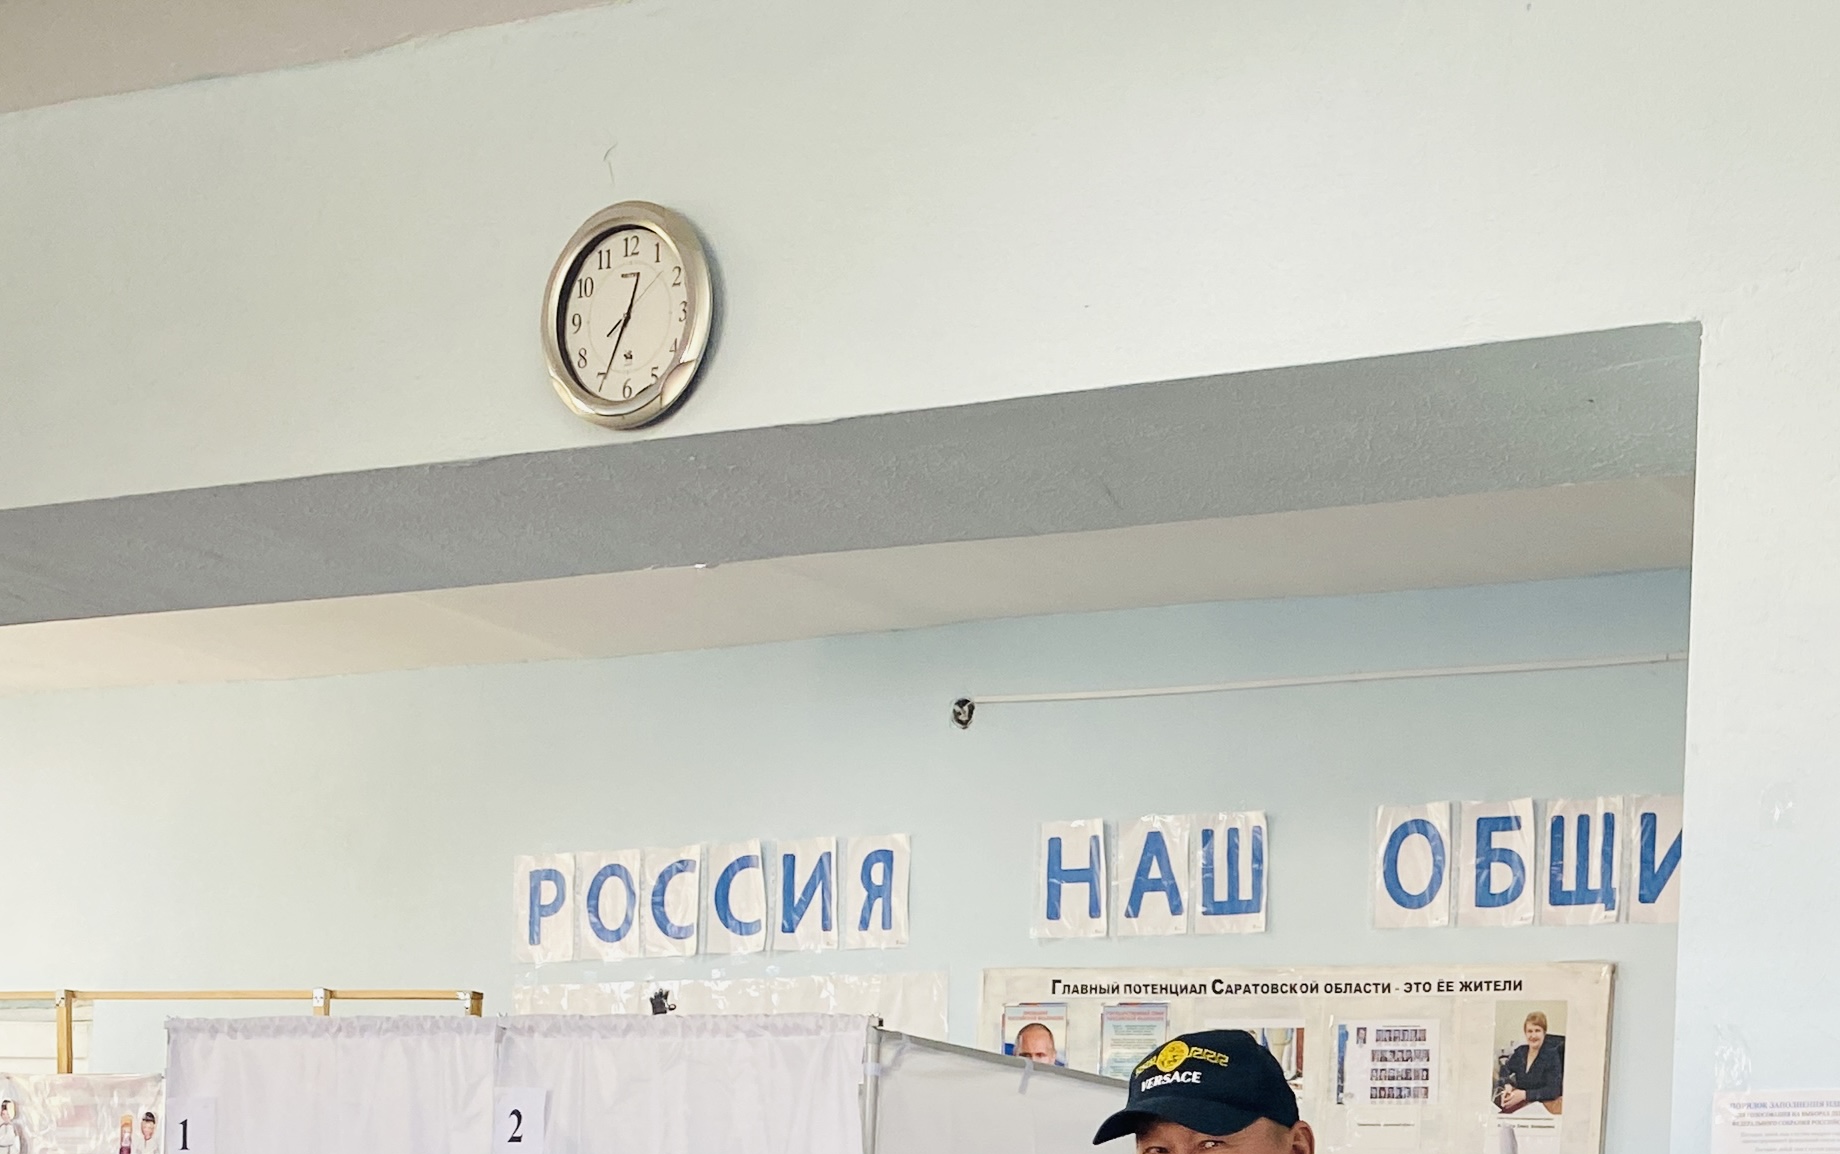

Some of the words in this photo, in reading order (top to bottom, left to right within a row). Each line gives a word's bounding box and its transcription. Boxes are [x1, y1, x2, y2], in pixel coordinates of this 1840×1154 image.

[623, 236, 639, 257] 12
[654, 243, 661, 262] 1
[598, 249, 612, 269] 11
[672, 266, 682, 287] 2
[578, 277, 594, 298] 10
[679, 301, 687, 322] 3
[572, 313, 582, 333] 9
[669, 338, 677, 353] 4
[578, 348, 587, 368] 8
[597, 372, 607, 391] 7
[651, 367, 658, 385] 5
[622, 378, 632, 398] 6
[528, 848, 895, 946] РОССИЯ
[1046, 827, 1264, 920] НАШ
[1124, 983, 1207, 997] ПОТЕНЦИАЛ
[1324, 982, 1391, 994] ОБЛАСТИ
[1404, 981, 1432, 993] ЭТО
[1459, 980, 1523, 992] ЖИТЕЛИ
[1141, 1071, 1202, 1092] VERSACE
[179, 1119, 190, 1150] 1
[507, 1109, 524, 1143] 2
